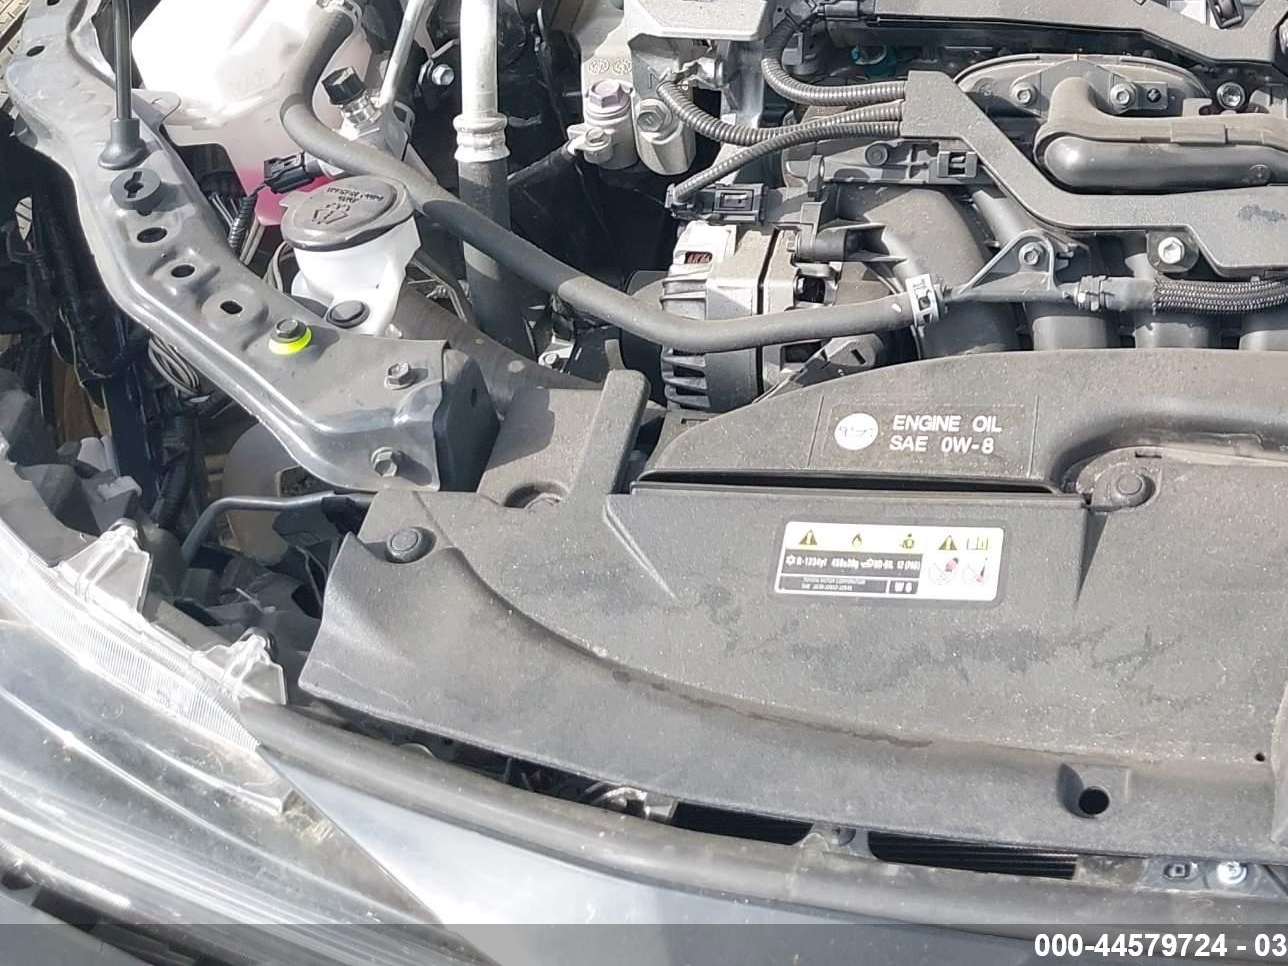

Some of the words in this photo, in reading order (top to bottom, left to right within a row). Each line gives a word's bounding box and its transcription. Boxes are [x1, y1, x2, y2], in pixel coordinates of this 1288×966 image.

[892, 414, 962, 432] ENGINE
[972, 415, 1003, 433] OIL
[889, 435, 929, 452] SAE
[941, 436, 995, 454] 0W-8
